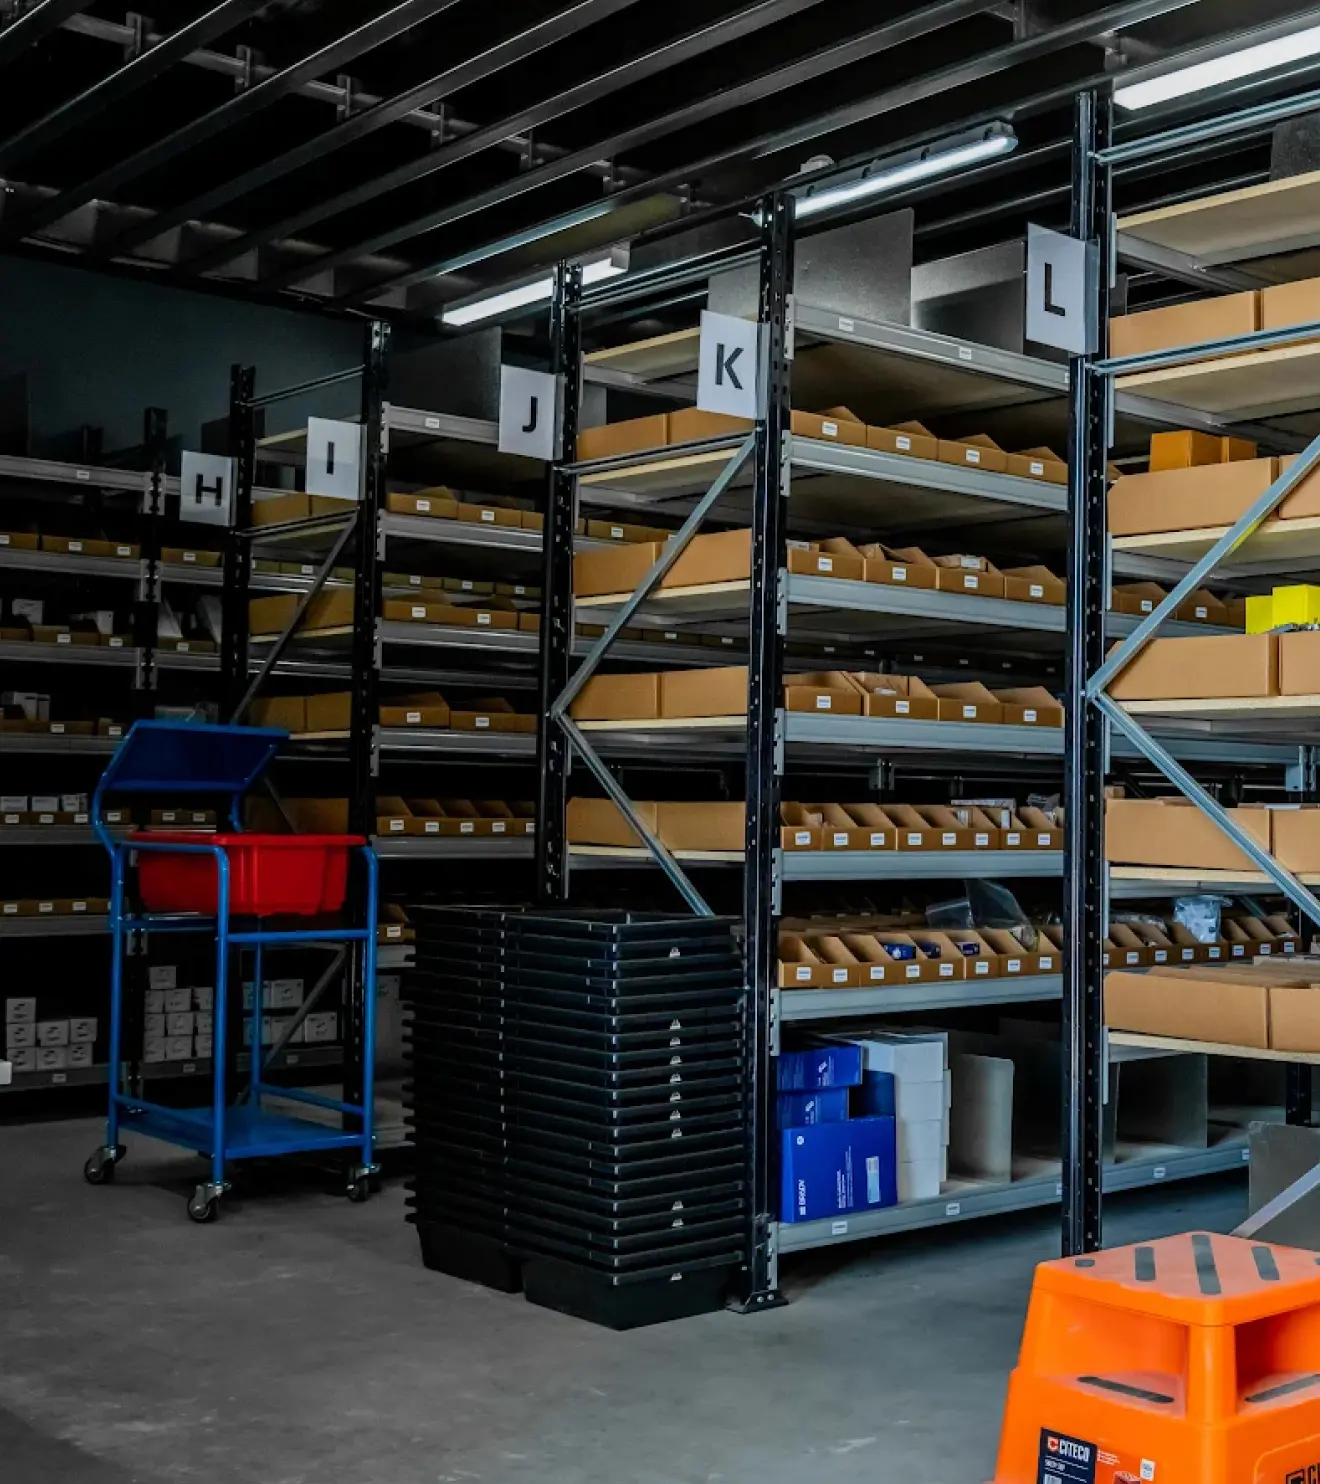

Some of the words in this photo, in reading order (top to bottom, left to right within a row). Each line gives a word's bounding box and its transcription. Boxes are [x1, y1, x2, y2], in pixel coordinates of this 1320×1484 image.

[1044, 261, 1066, 317] L
[714, 342, 744, 391] K
[521, 395, 539, 434] J
[326, 441, 335, 476] I
[195, 473, 224, 508] H
[1059, 1438, 1091, 1462] CITECO
